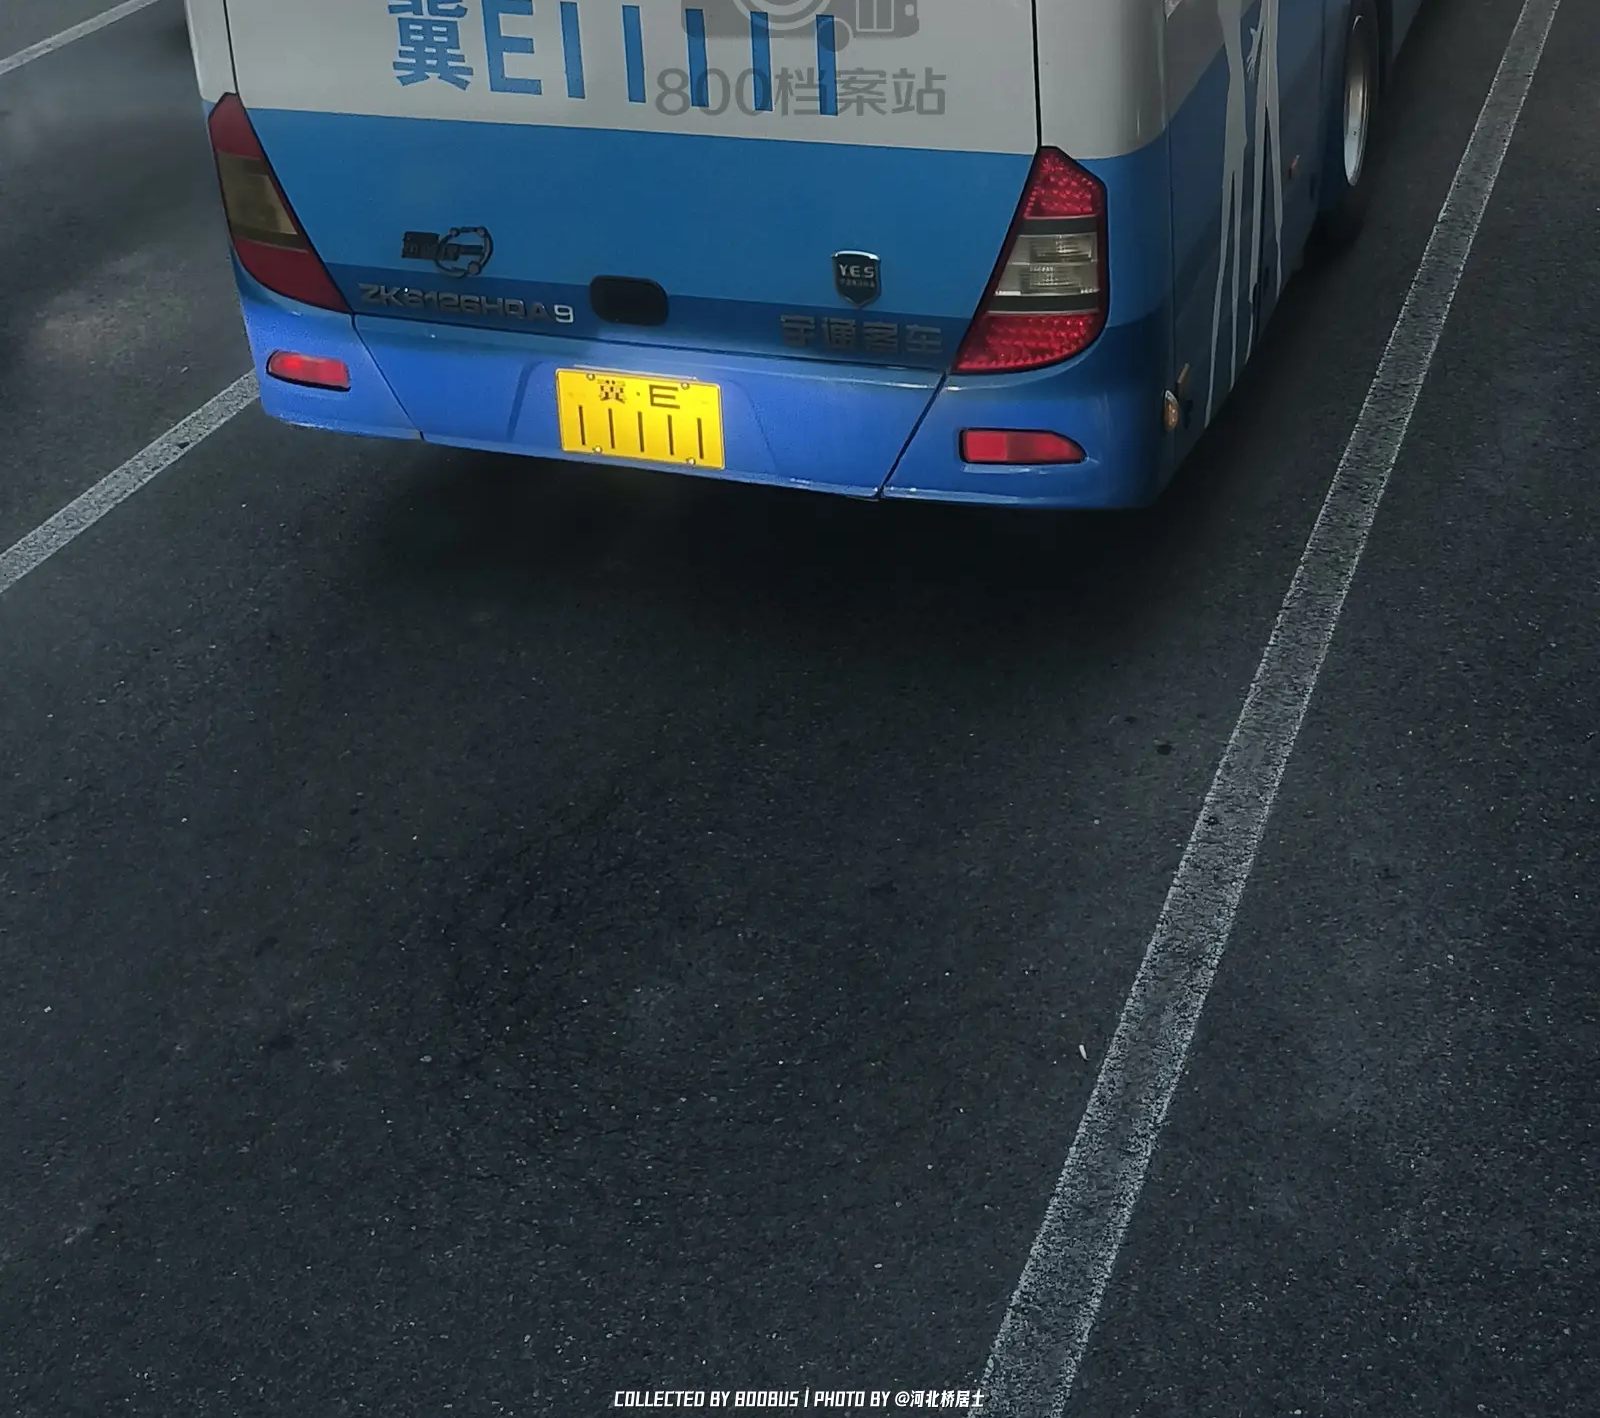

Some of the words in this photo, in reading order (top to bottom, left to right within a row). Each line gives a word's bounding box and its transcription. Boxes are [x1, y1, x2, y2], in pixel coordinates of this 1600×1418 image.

[839, 263, 876, 279] YES
[780, 314, 943, 354] 宇通客车
